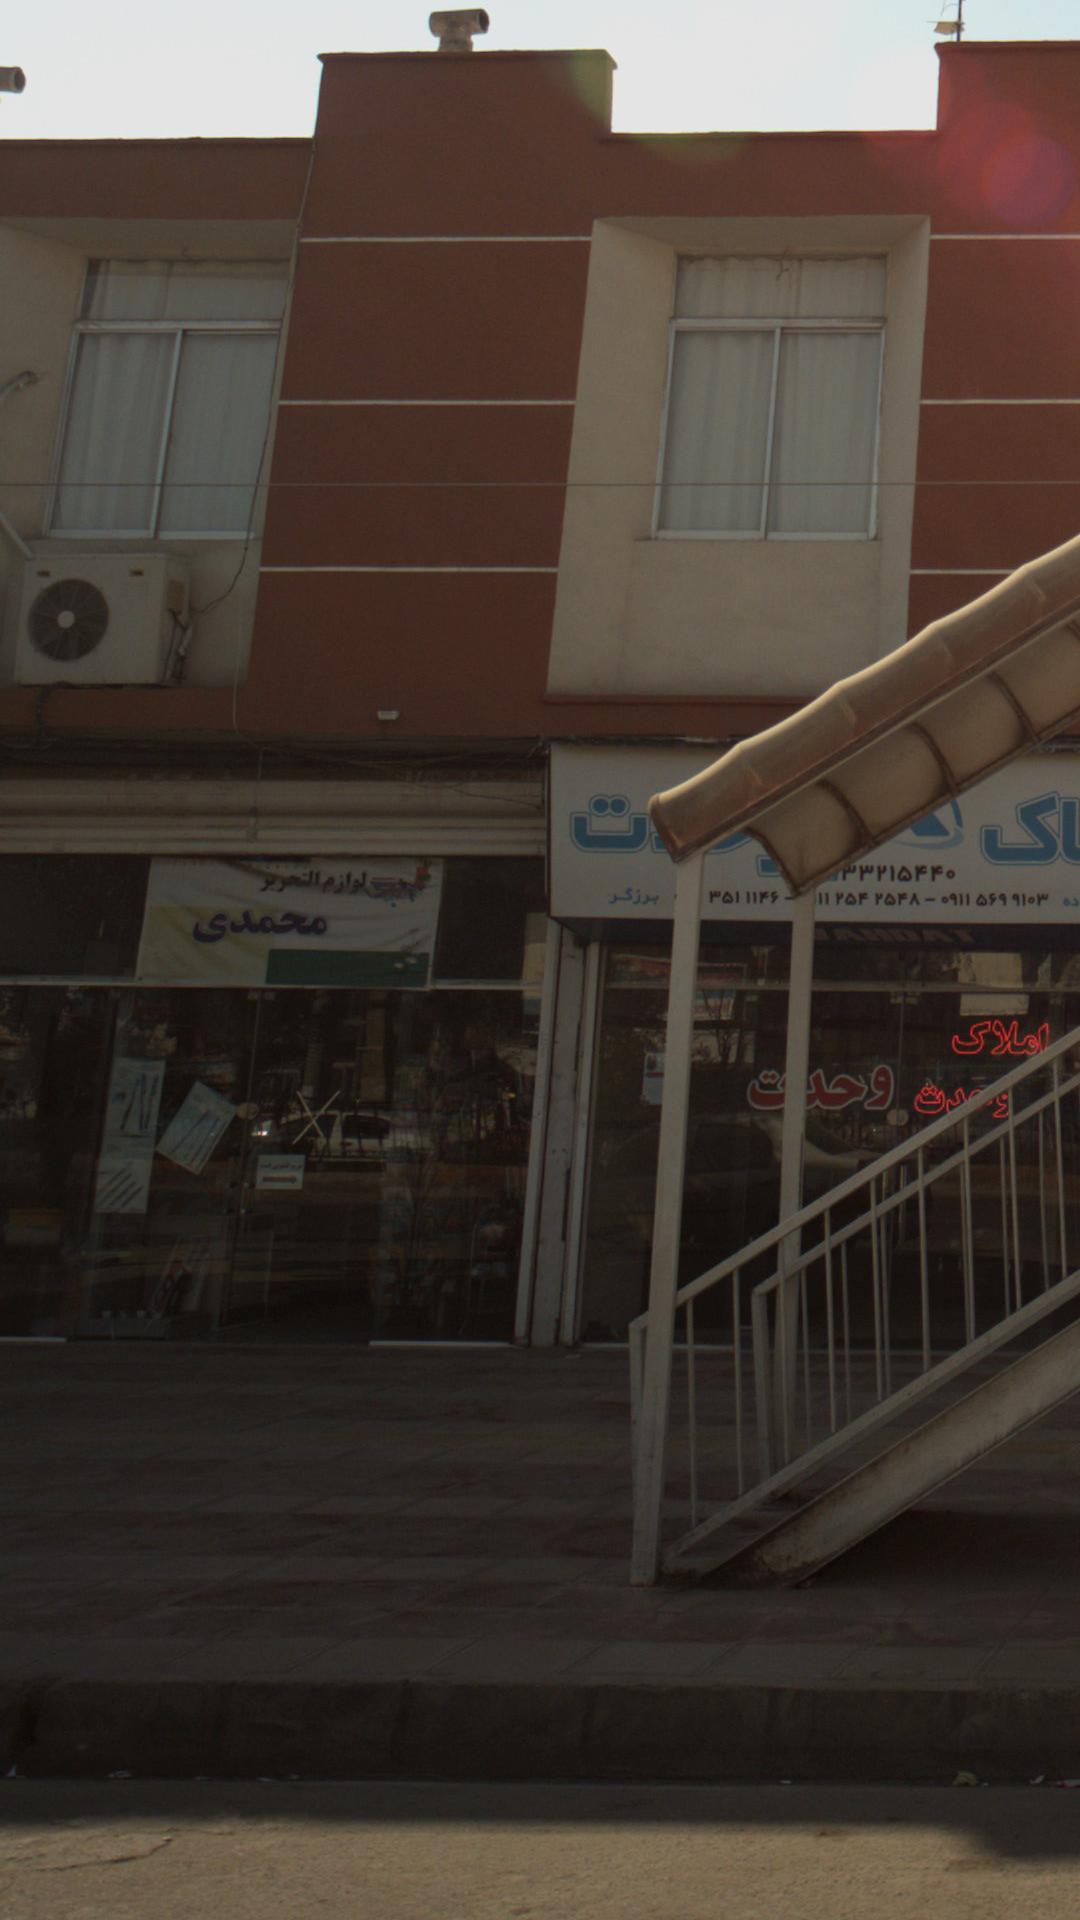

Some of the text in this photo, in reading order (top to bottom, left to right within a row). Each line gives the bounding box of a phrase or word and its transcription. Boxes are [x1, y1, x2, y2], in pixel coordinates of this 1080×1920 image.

[260, 870, 366, 894] لوازم التحریر
[709, 890, 740, 904] ۳۵۱
[835, 892, 868, 906] ۲۵۴
[875, 892, 921, 906] ۲۵۴۸
[941, 892, 970, 906] ۰۹۱۱
[976, 892, 1006, 907] ۵۶۹
[192, 910, 327, 943] محمدی
[951, 1018, 1049, 1056] املاک
[746, 1064, 895, 1111] وحدت
